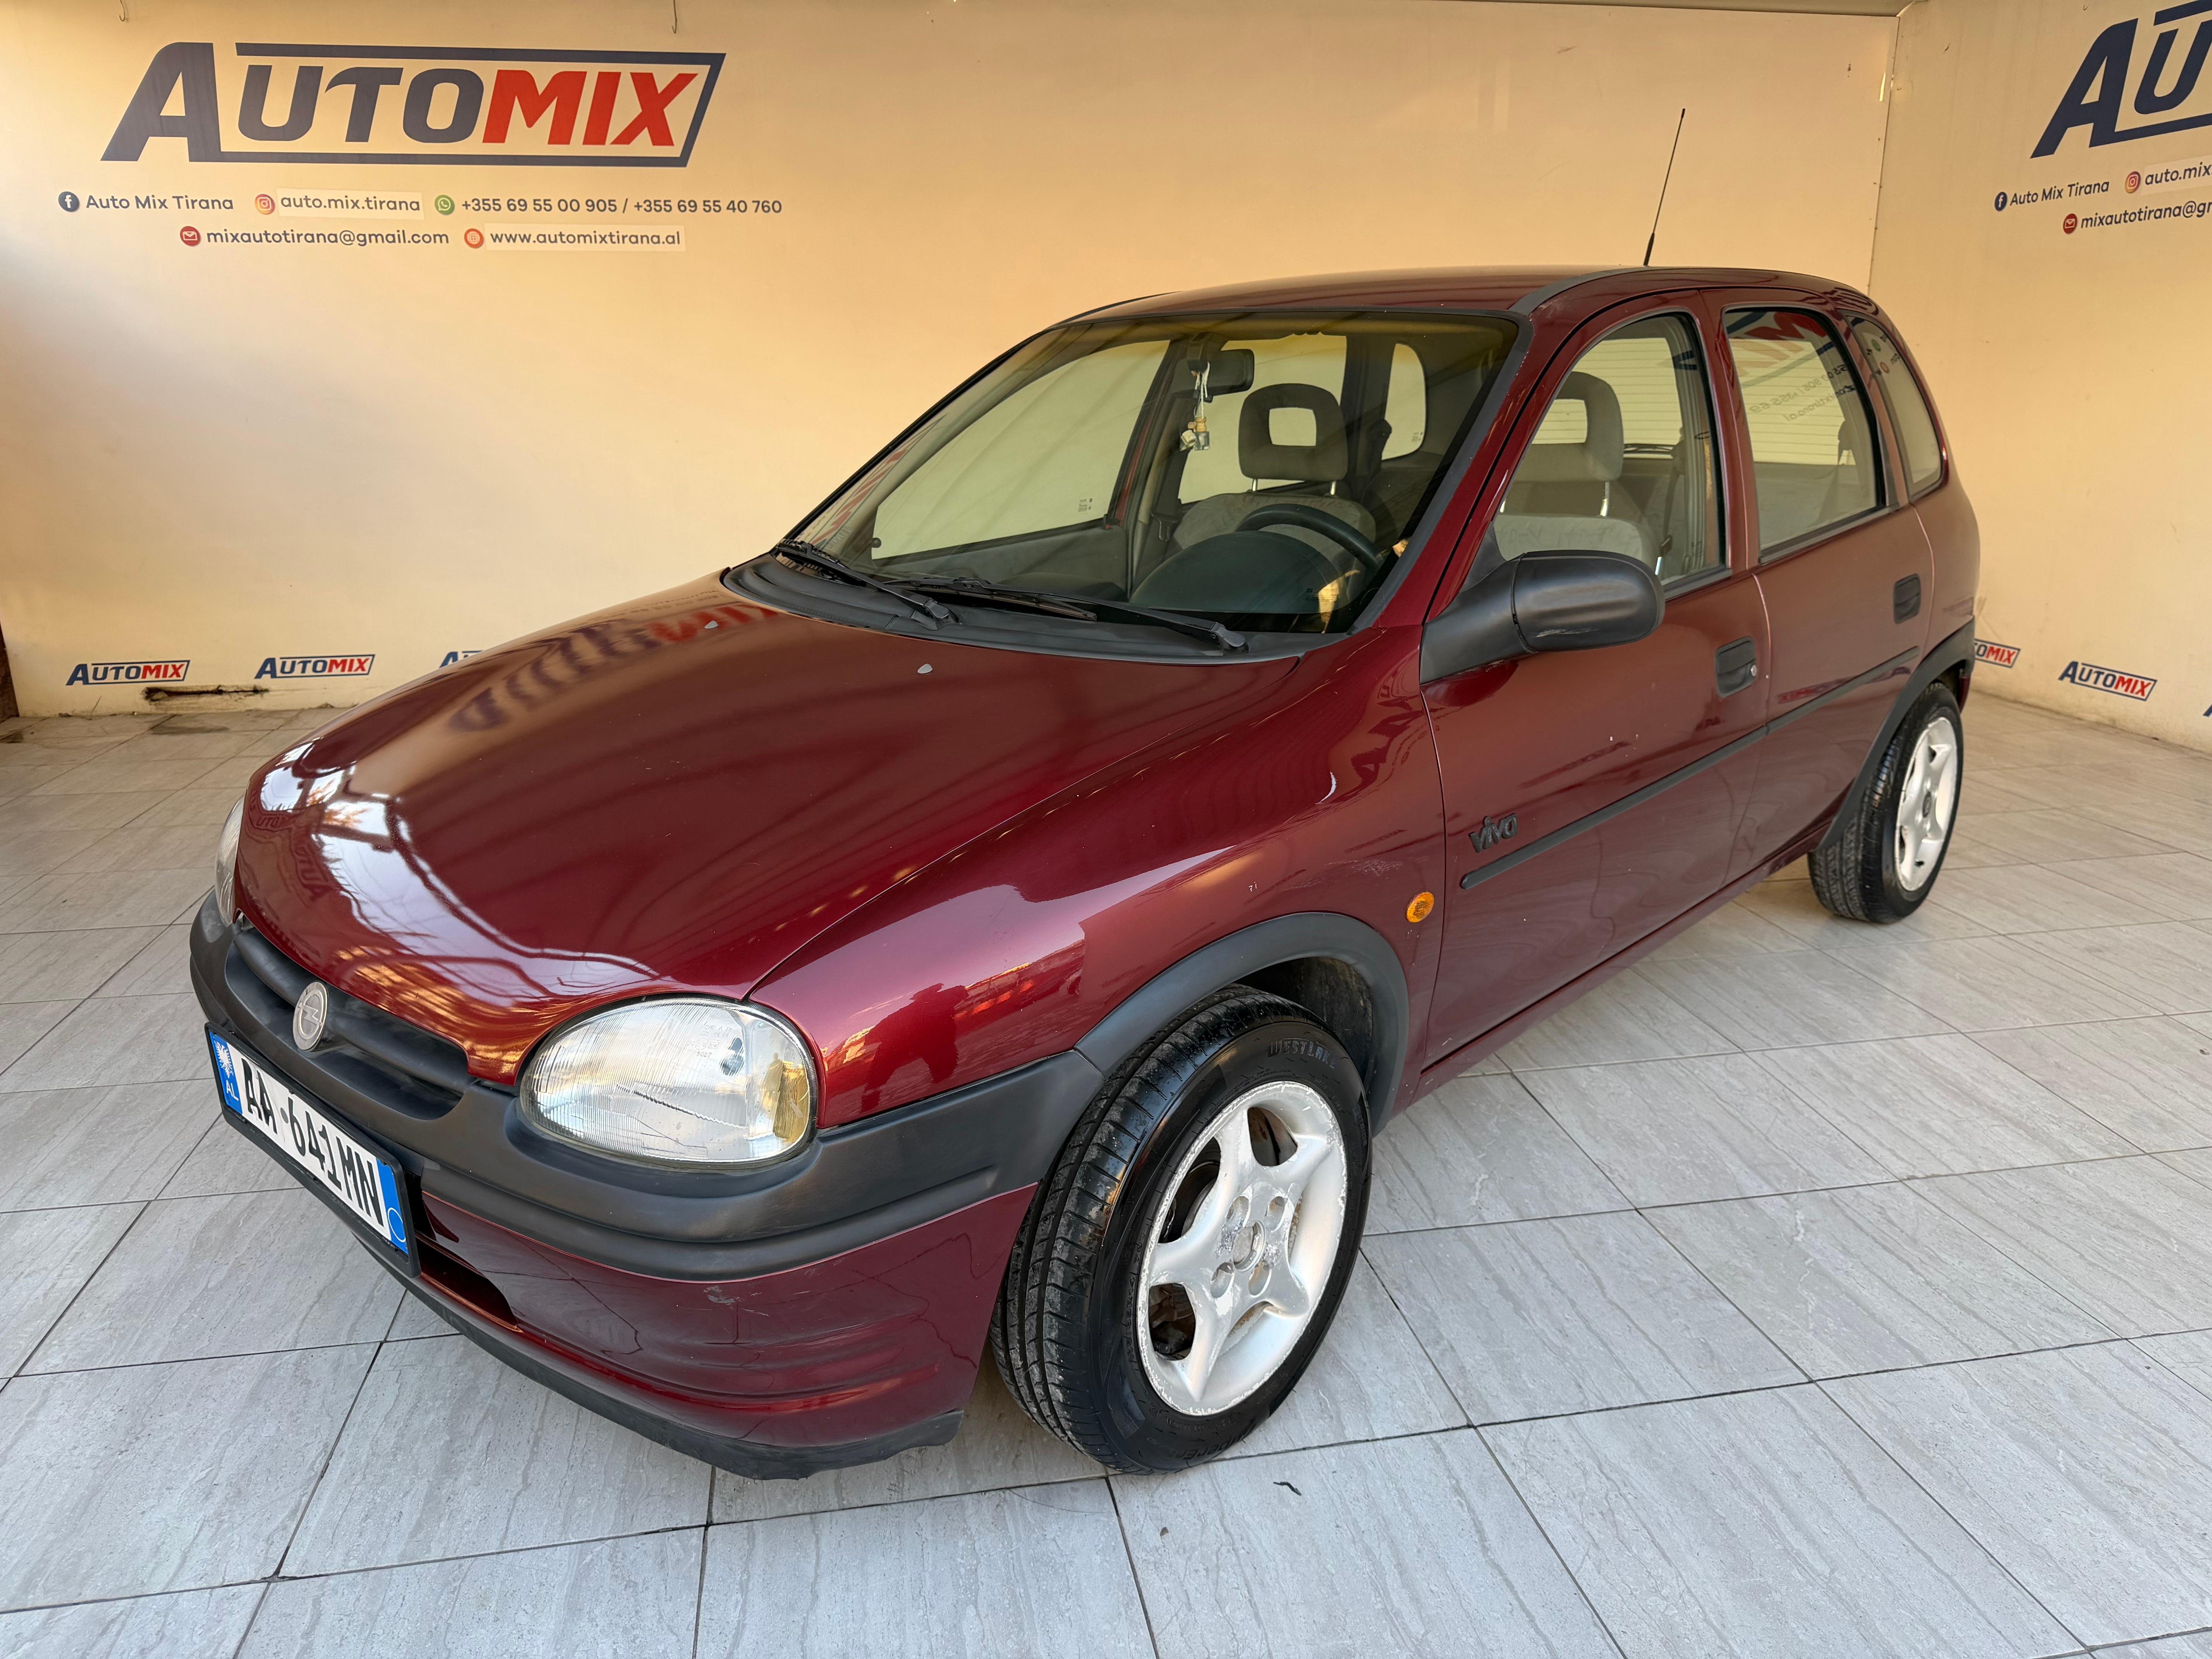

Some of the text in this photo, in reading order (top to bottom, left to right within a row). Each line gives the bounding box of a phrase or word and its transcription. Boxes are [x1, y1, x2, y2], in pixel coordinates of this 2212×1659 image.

[100, 42, 699, 162] AUTOMIX
[2145, 162, 2212, 185] auto.mix
[86, 195, 234, 210] Auto Mix Tirana
[281, 195, 420, 211] auto.mix.tirana
[2010, 180, 2110, 206] Auto Mix Tirana
[462, 198, 782, 213] +355 69 55 00 905 / +355 69 55 40 760
[207, 228, 449, 247] mixautotirana@gmail.com
[490, 231, 680, 244] www.automixtirana.al
[1975, 642, 2016, 664] OMIX
[65, 663, 185, 685] AUTOMIX
[254, 657, 371, 679] AUTOMIX
[2058, 660, 2152, 697] AUTOMIX
[1268, 1039, 1337, 1069] WESTLAKE
[226, 1080, 239, 1101] AL
[240, 1058, 278, 1135] AA
